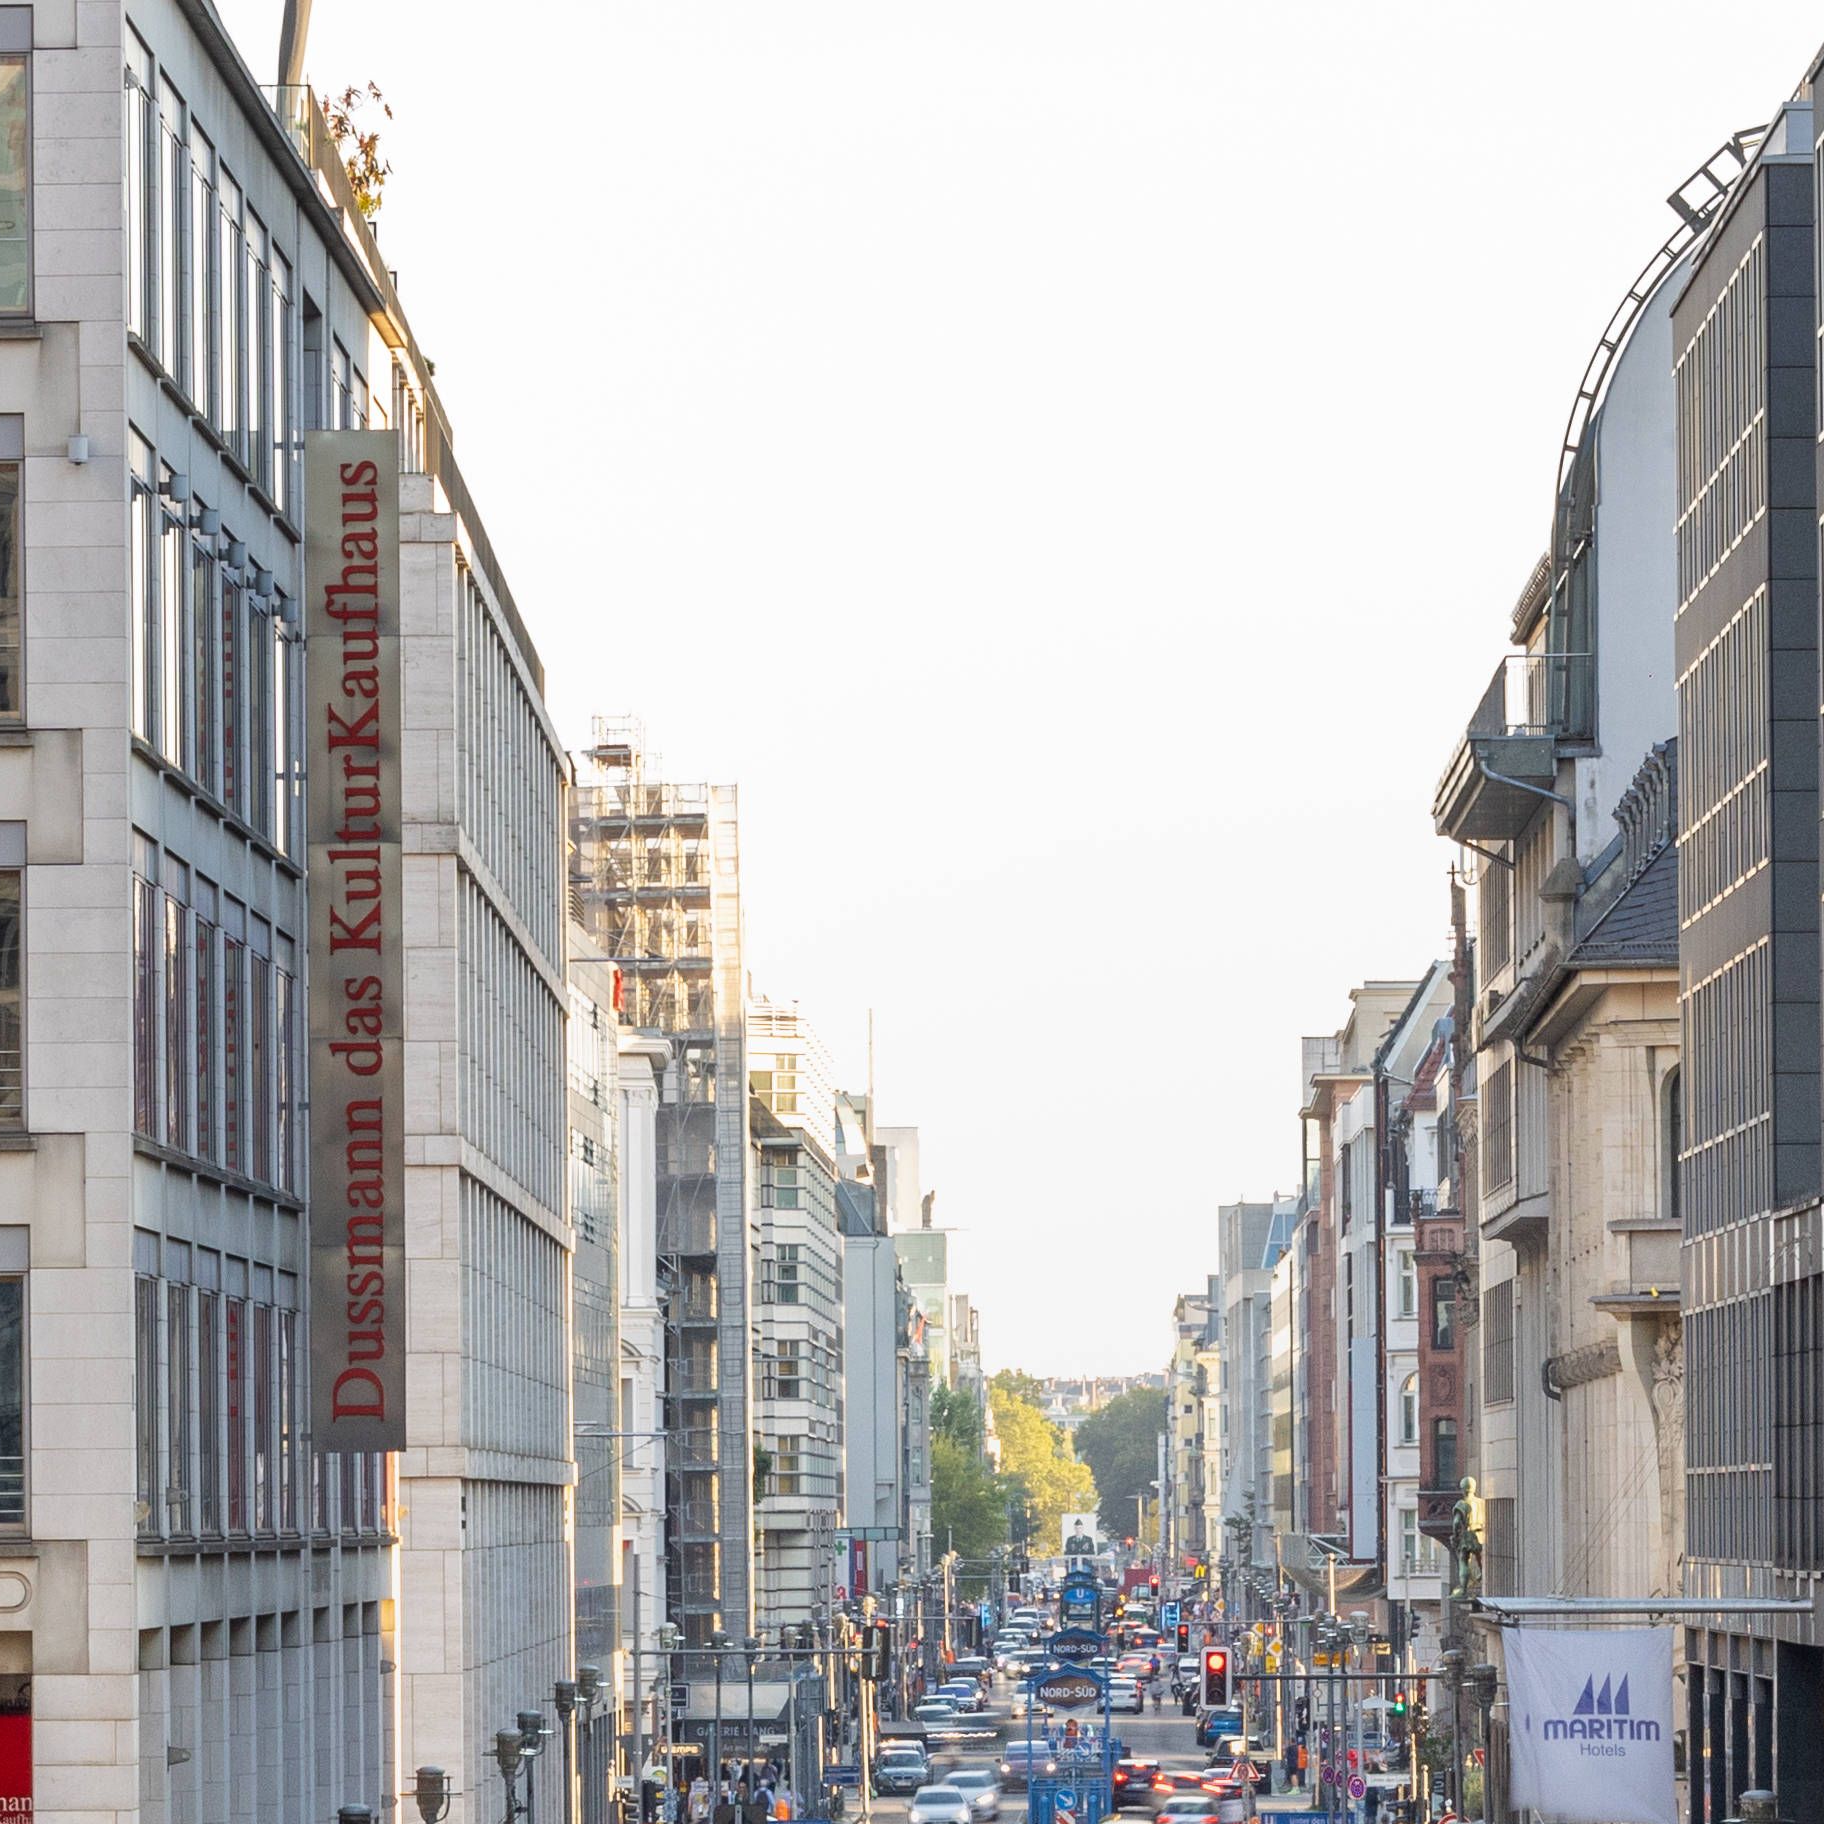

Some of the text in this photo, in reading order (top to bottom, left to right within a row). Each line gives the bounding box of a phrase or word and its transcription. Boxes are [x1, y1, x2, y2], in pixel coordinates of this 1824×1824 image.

[327, 461, 388, 1424] Dussmann das KulturKaufhaus
[1040, 1684, 1097, 1699] NORD-SÜD
[697, 1726, 775, 1737] GAERIE LANG
[1544, 1719, 1660, 1741] MARITIM
[1580, 1743, 1626, 1757] Hotels
